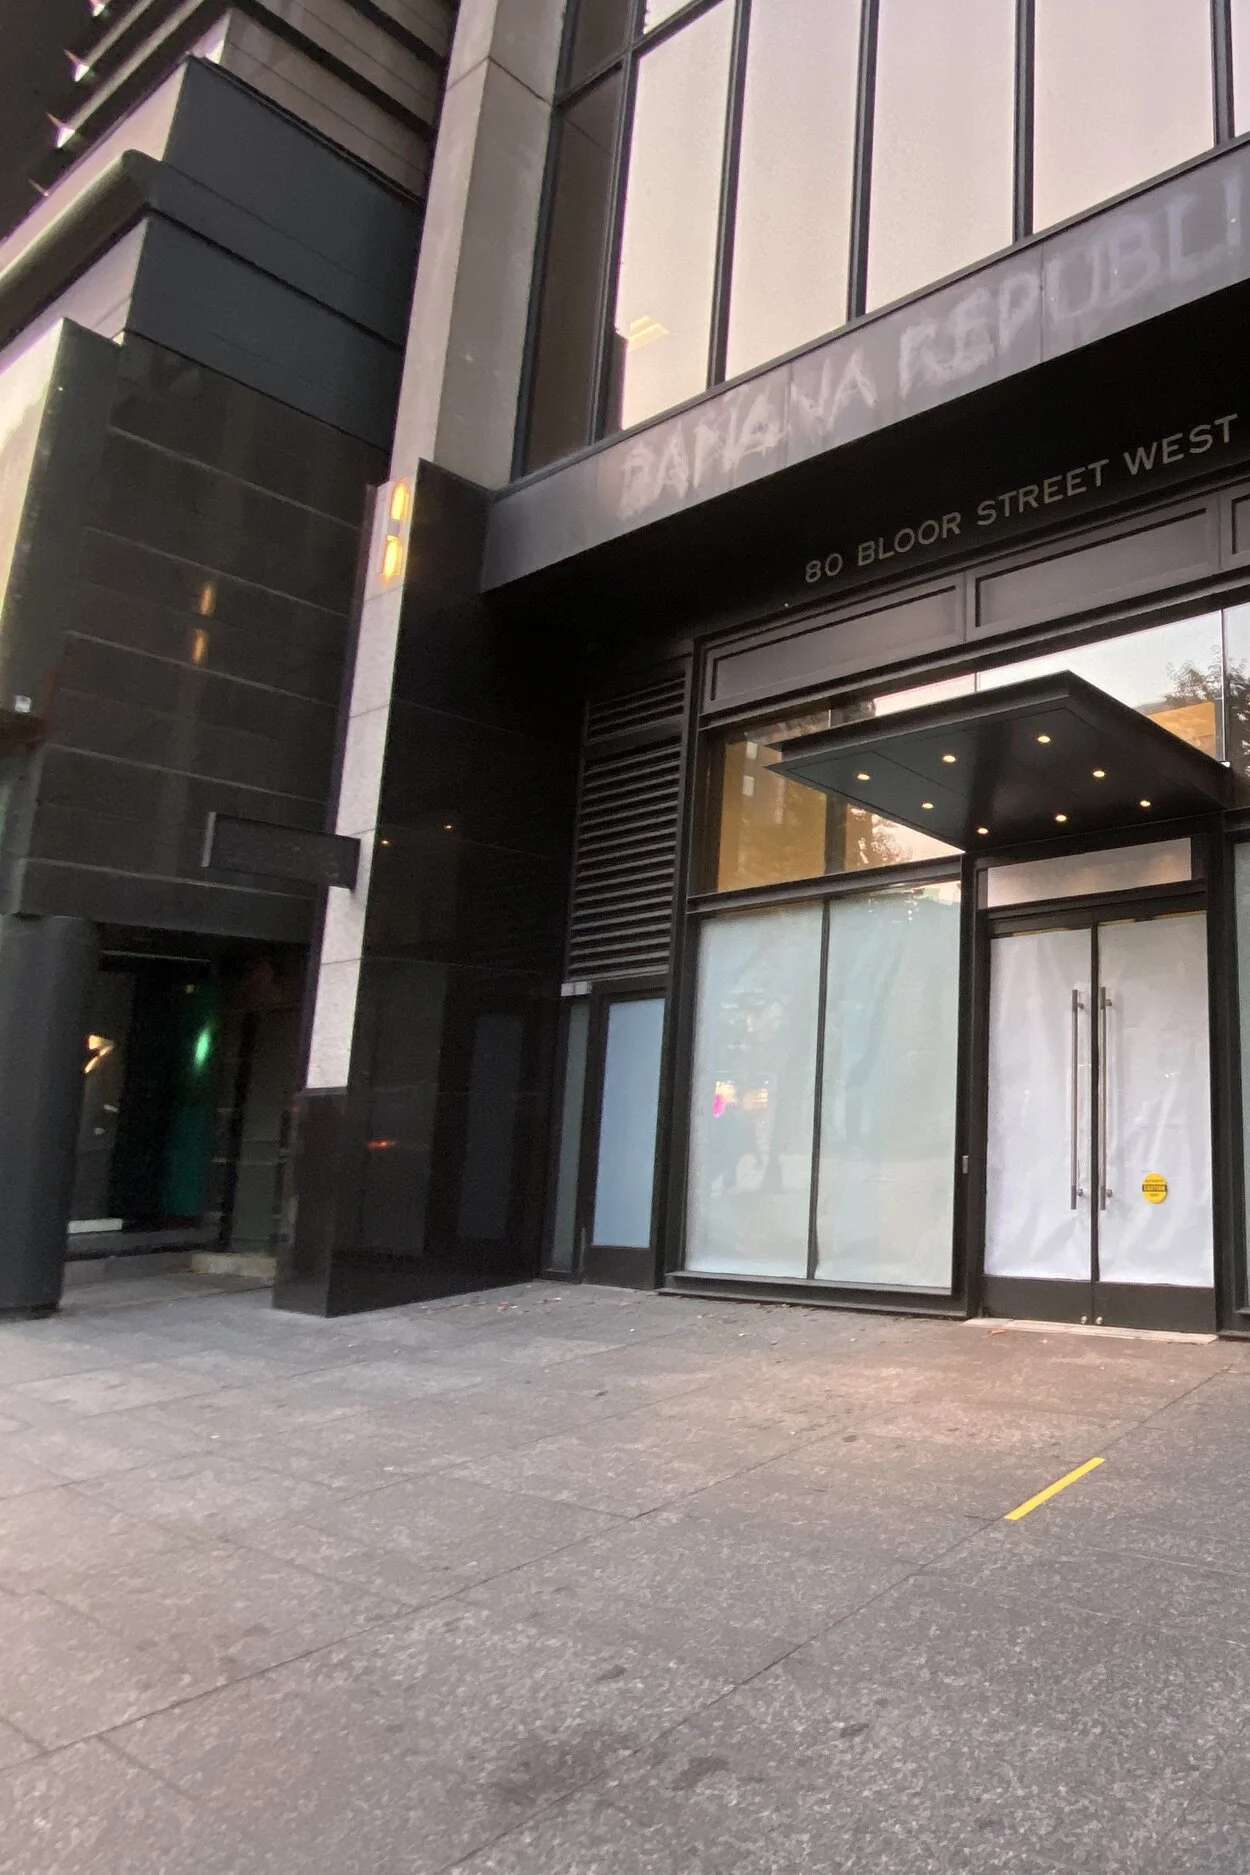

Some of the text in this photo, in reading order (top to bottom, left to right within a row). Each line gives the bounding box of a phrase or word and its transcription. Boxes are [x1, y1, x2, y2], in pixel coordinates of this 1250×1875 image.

[803, 412, 1239, 585] 80 BLOOR STREET WEST
